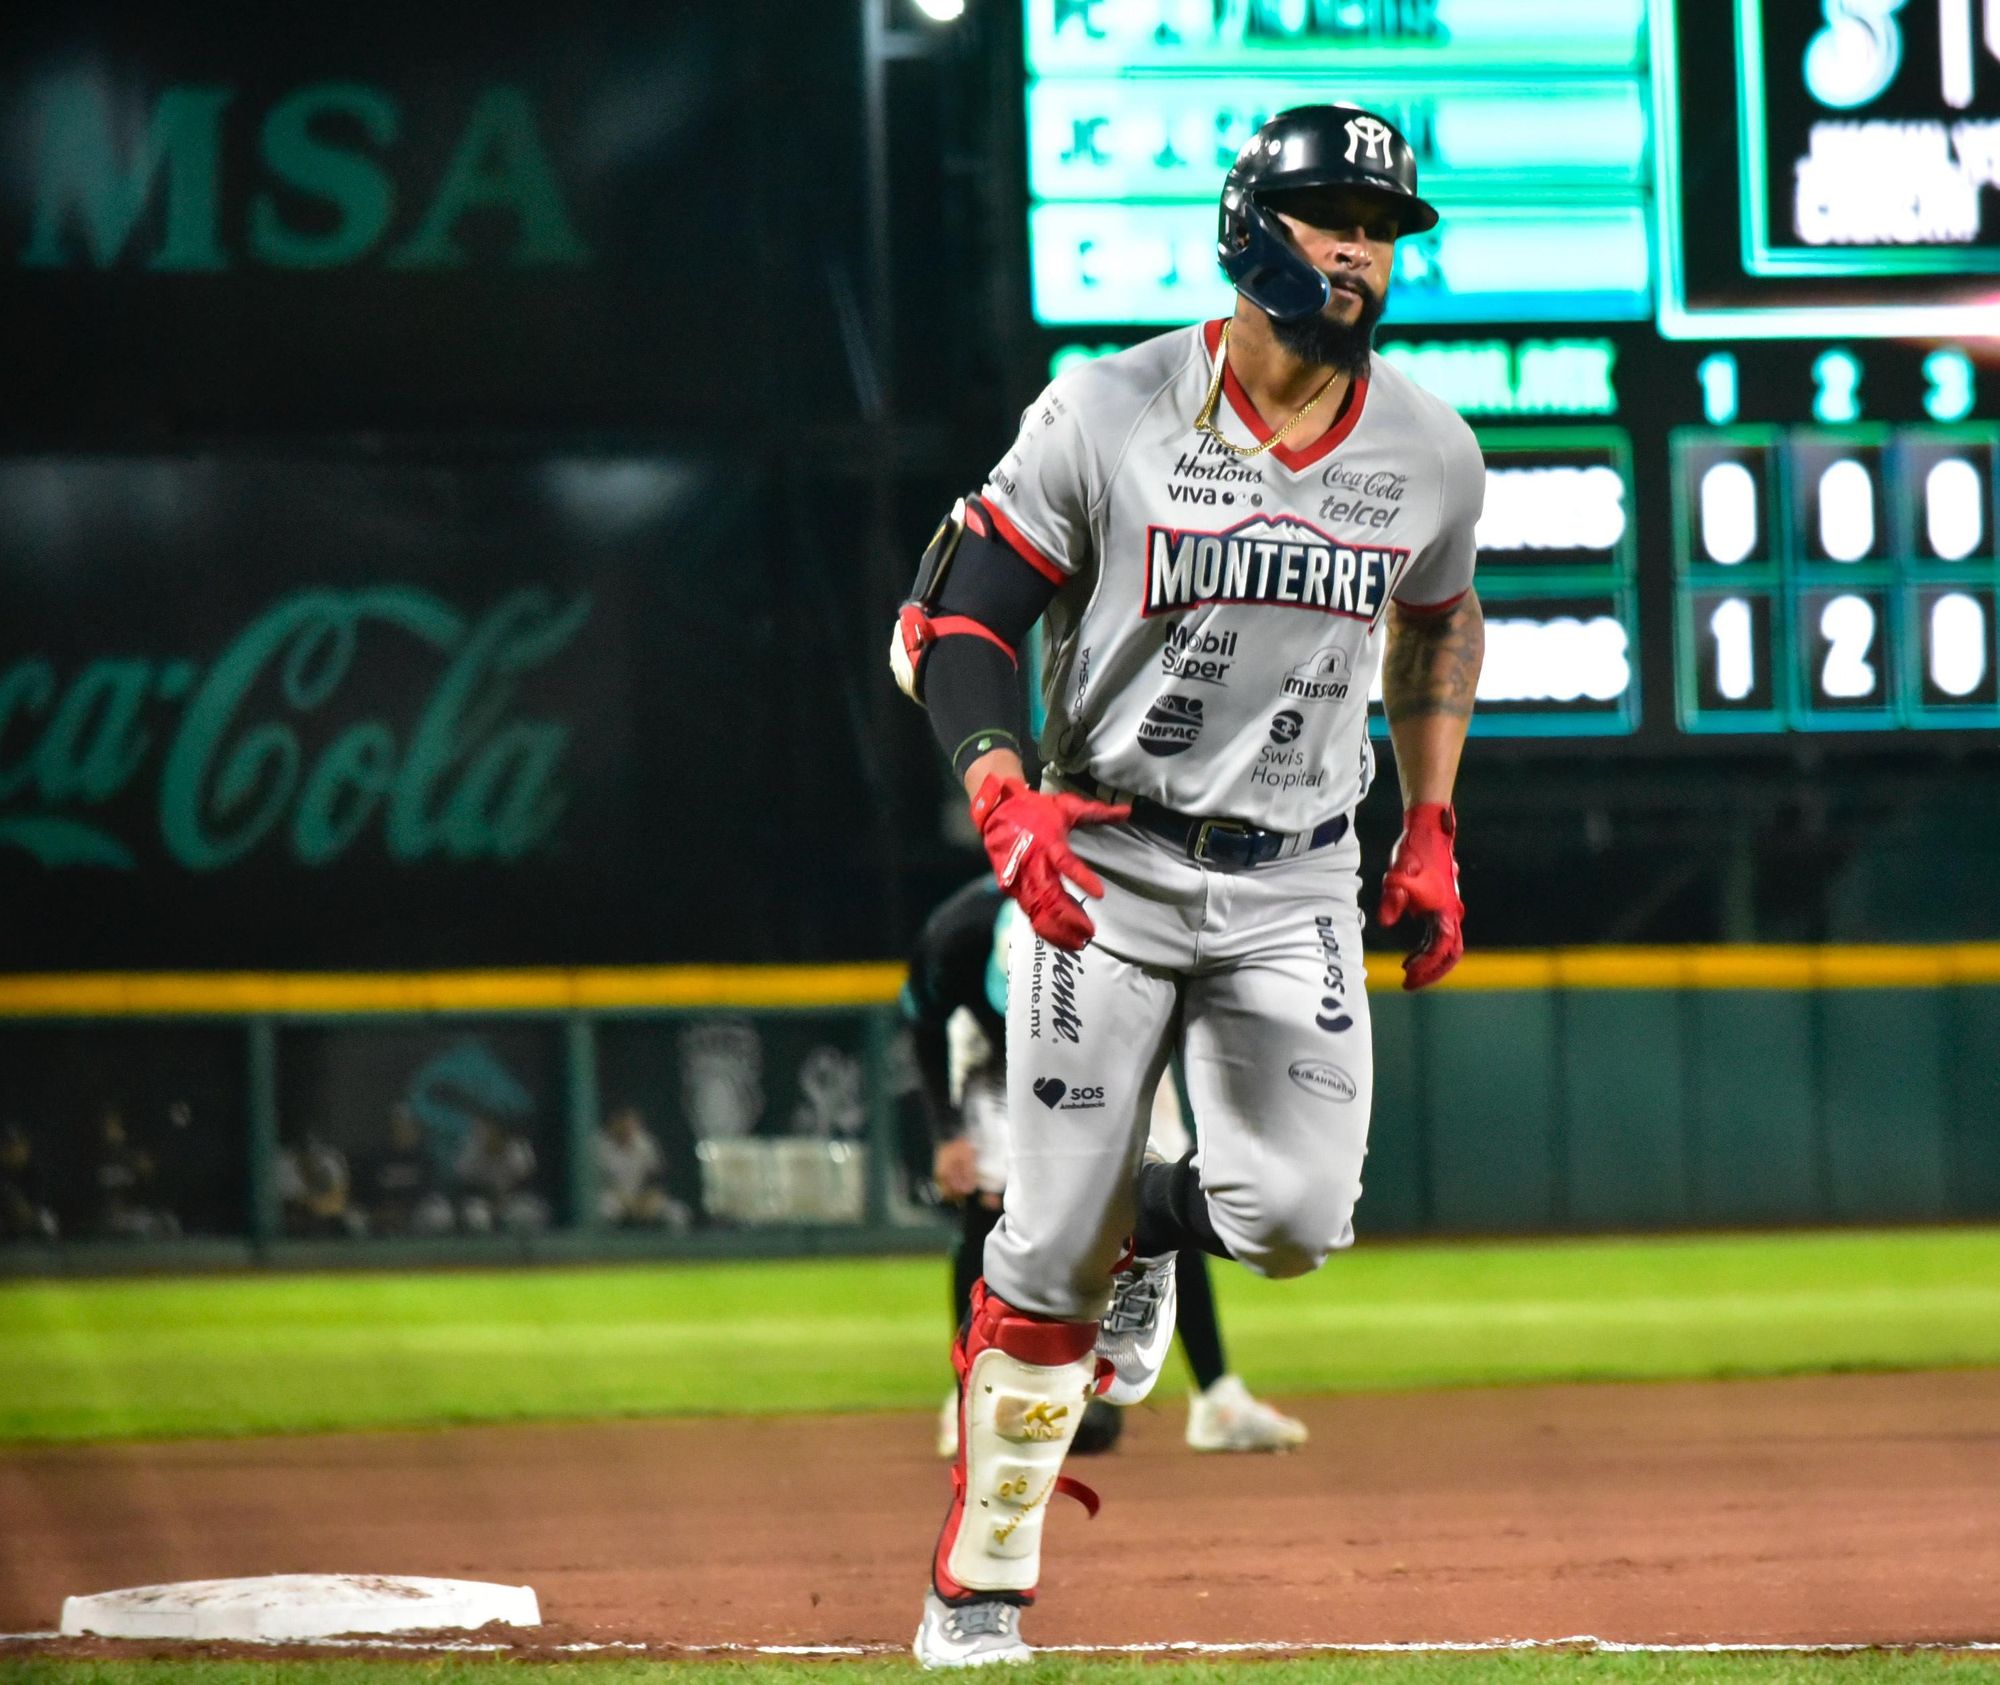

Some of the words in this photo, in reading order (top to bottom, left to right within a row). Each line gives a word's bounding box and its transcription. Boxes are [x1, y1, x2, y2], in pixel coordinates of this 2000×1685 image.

[18, 82, 598, 271] MSA
[1699, 351, 1739, 426] 1
[1811, 347, 1863, 424] 2
[1921, 346, 1977, 424] 3
[1174, 452, 1265, 484] Hortons
[1319, 495, 1400, 529] telcel
[1150, 531, 1405, 620] MONTERREY
[1165, 620, 1238, 657] Mobil
[1711, 597, 1754, 700] 1
[1820, 594, 1876, 698] 2
[1161, 646, 1230, 680] Super
[1138, 721, 1199, 741] IMPAC
[1030, 934, 1047, 1039] aliente.mx
[1070, 1086, 1105, 1100] SOS
